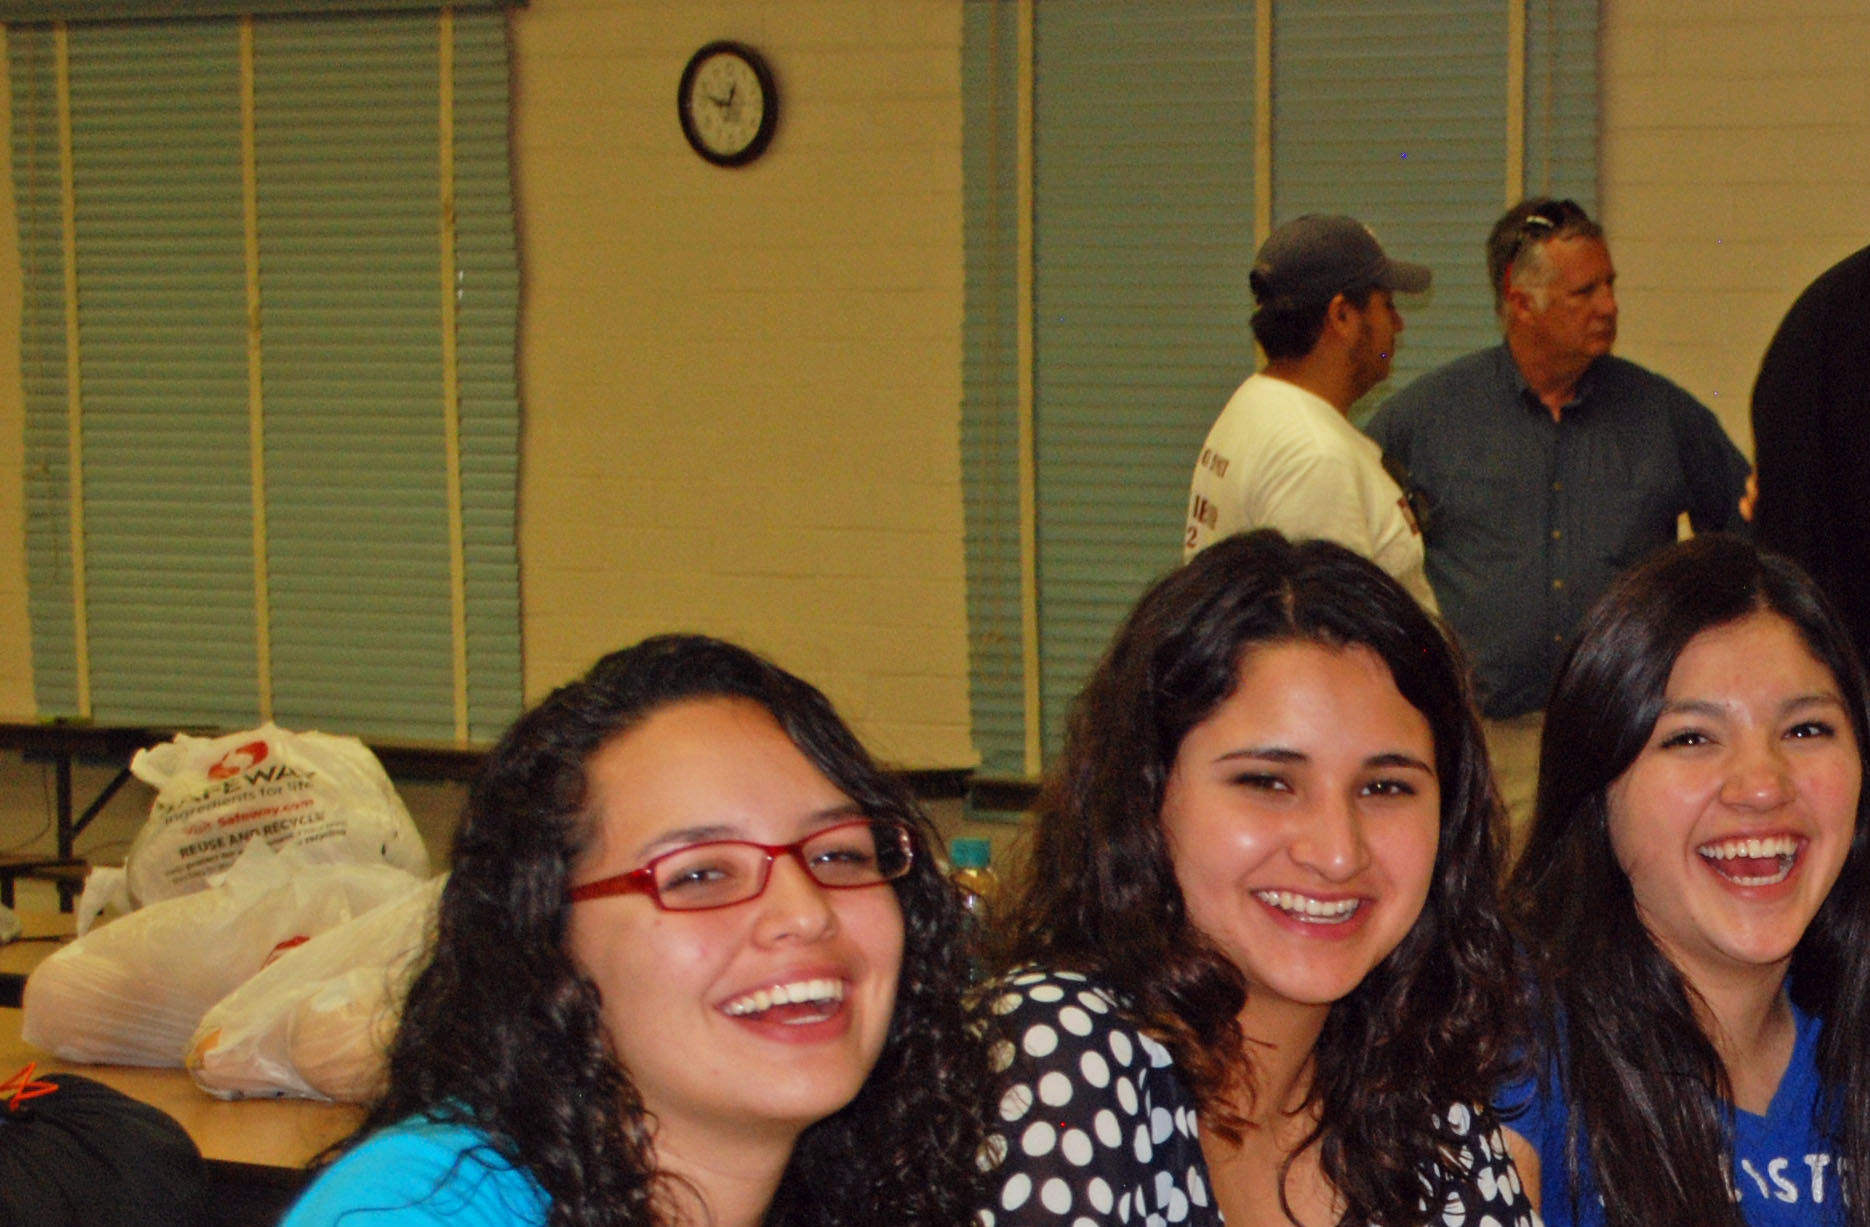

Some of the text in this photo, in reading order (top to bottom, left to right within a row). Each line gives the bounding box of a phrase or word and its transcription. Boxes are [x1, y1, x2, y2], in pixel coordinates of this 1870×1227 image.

[260, 785, 283, 798] for
[217, 799, 315, 828] Safeway.com
[180, 836, 226, 859] REUSE
